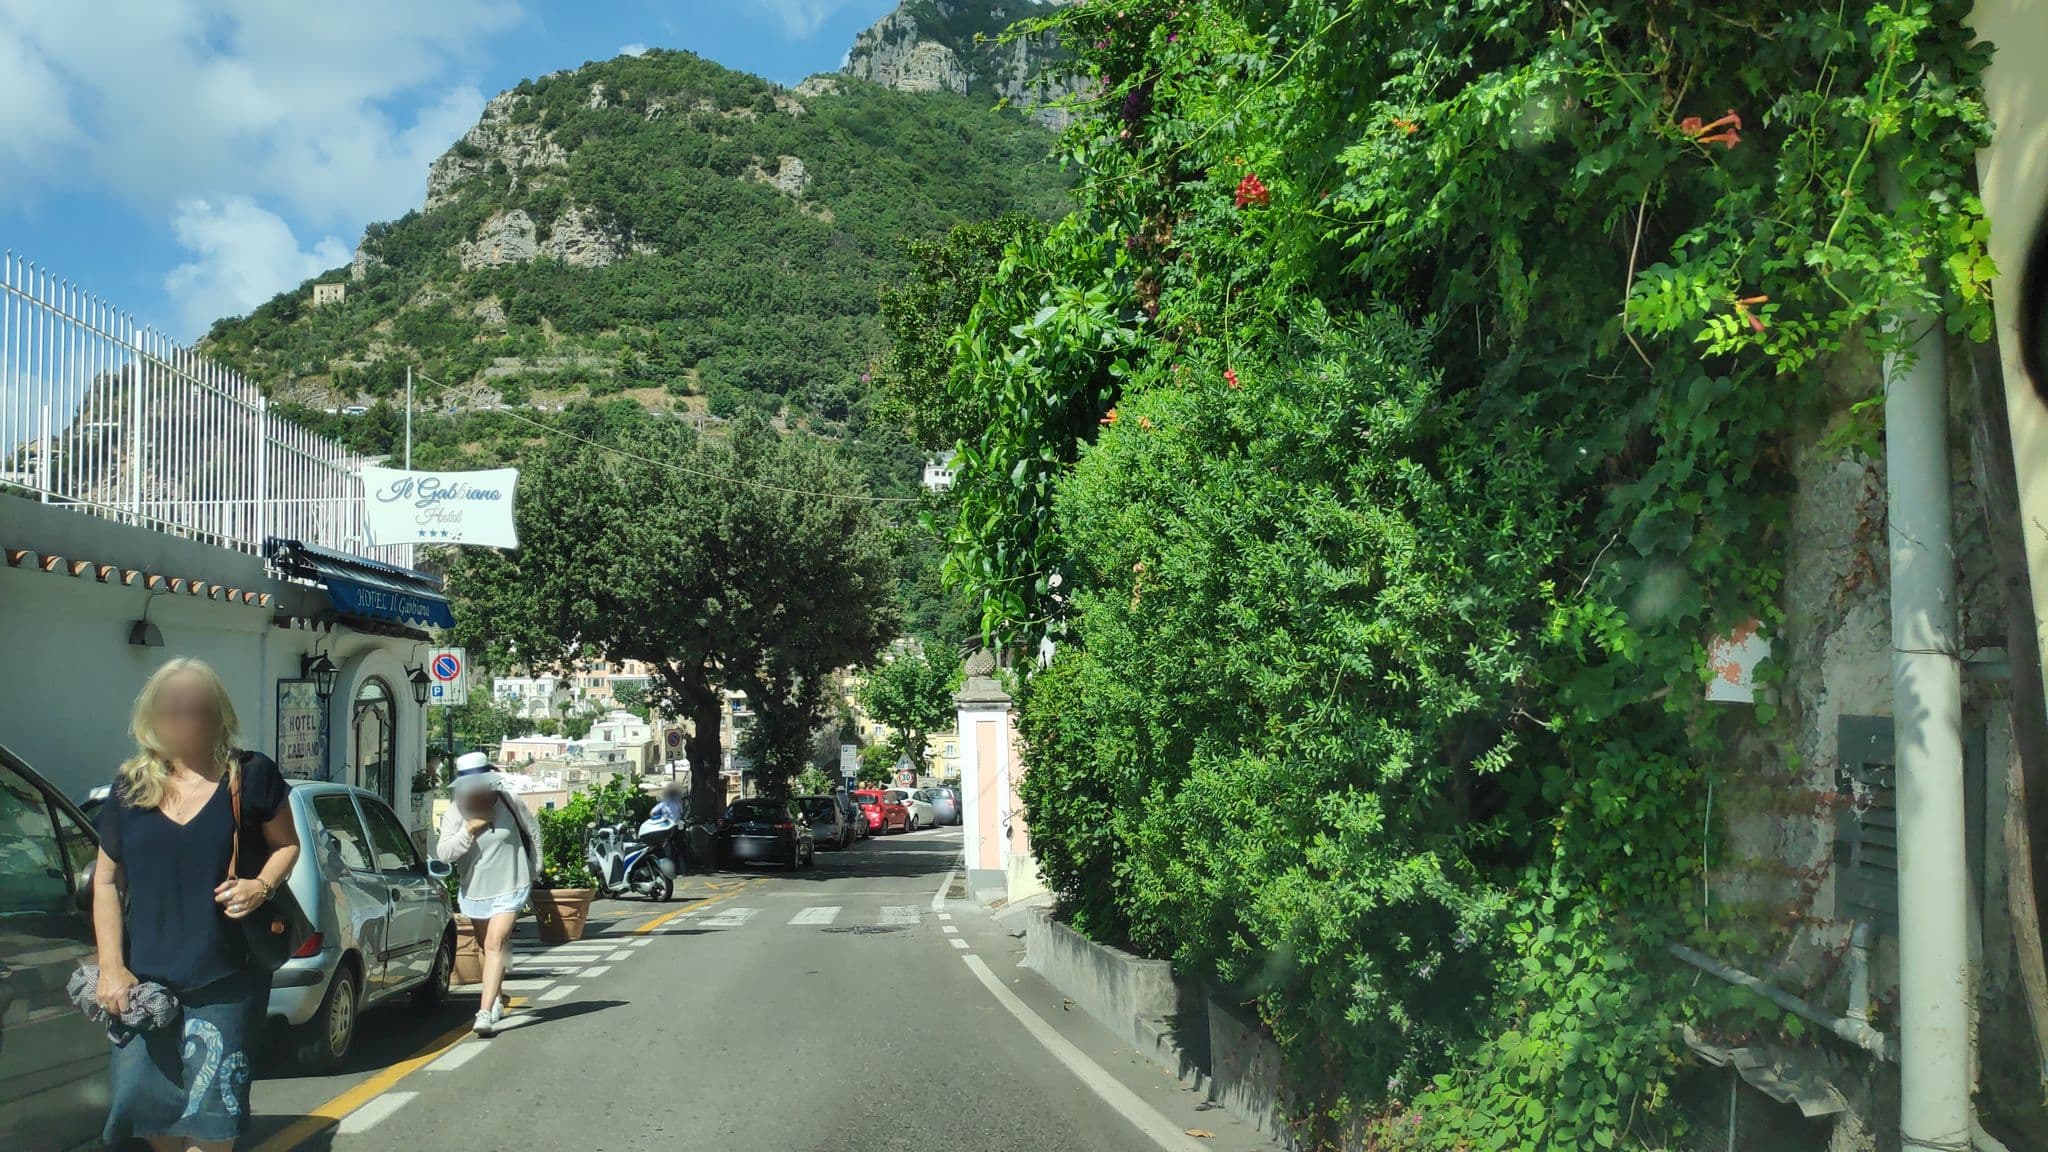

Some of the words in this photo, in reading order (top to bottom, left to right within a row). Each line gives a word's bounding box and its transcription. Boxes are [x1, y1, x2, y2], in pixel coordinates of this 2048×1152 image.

[376, 476, 414, 502] Il
[416, 507, 463, 525] Hotel
[357, 588, 387, 610] HOTEL
[289, 714, 316, 731] HOTEL
[901, 773, 911, 781] 30
